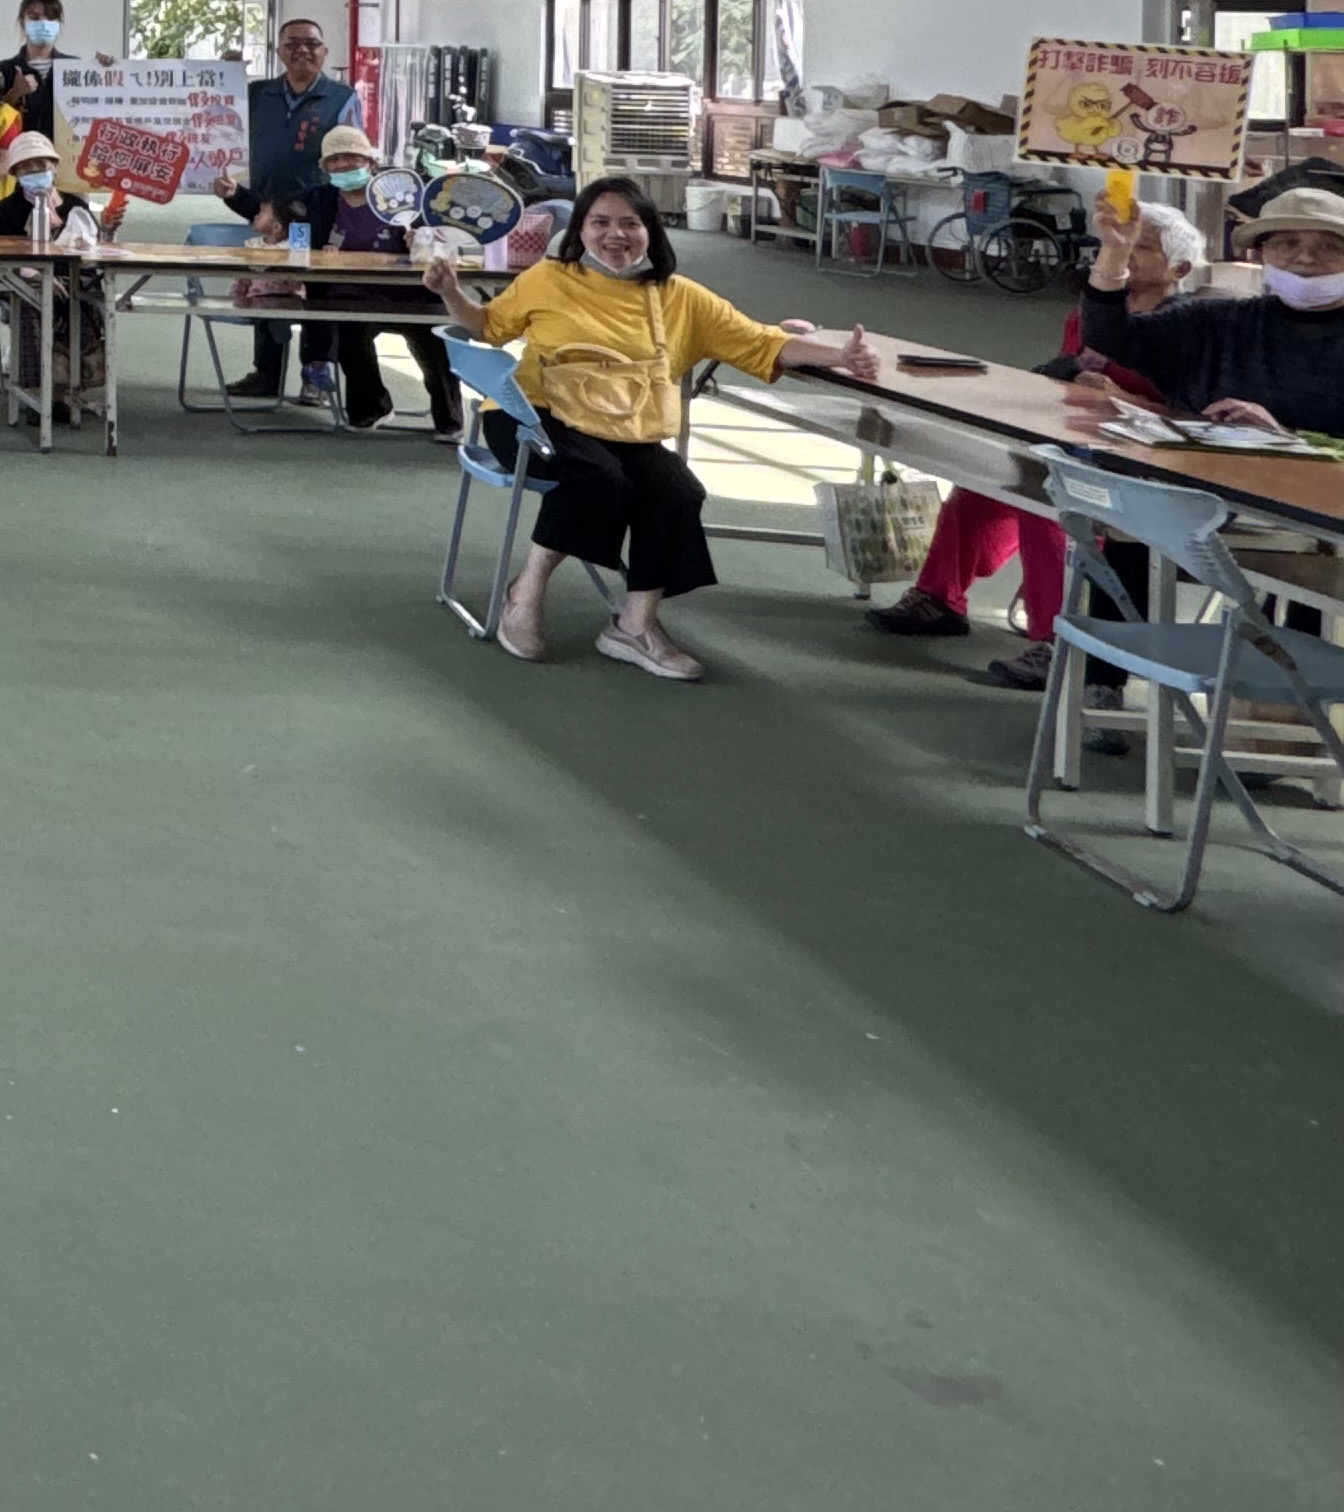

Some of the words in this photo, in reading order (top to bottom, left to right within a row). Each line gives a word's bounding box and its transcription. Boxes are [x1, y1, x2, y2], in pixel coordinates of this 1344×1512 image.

[1037, 50, 1134, 76] 打擊詐騙
[1145, 57, 1243, 85] 刻不容緩
[99, 123, 182, 162] 行政執行
